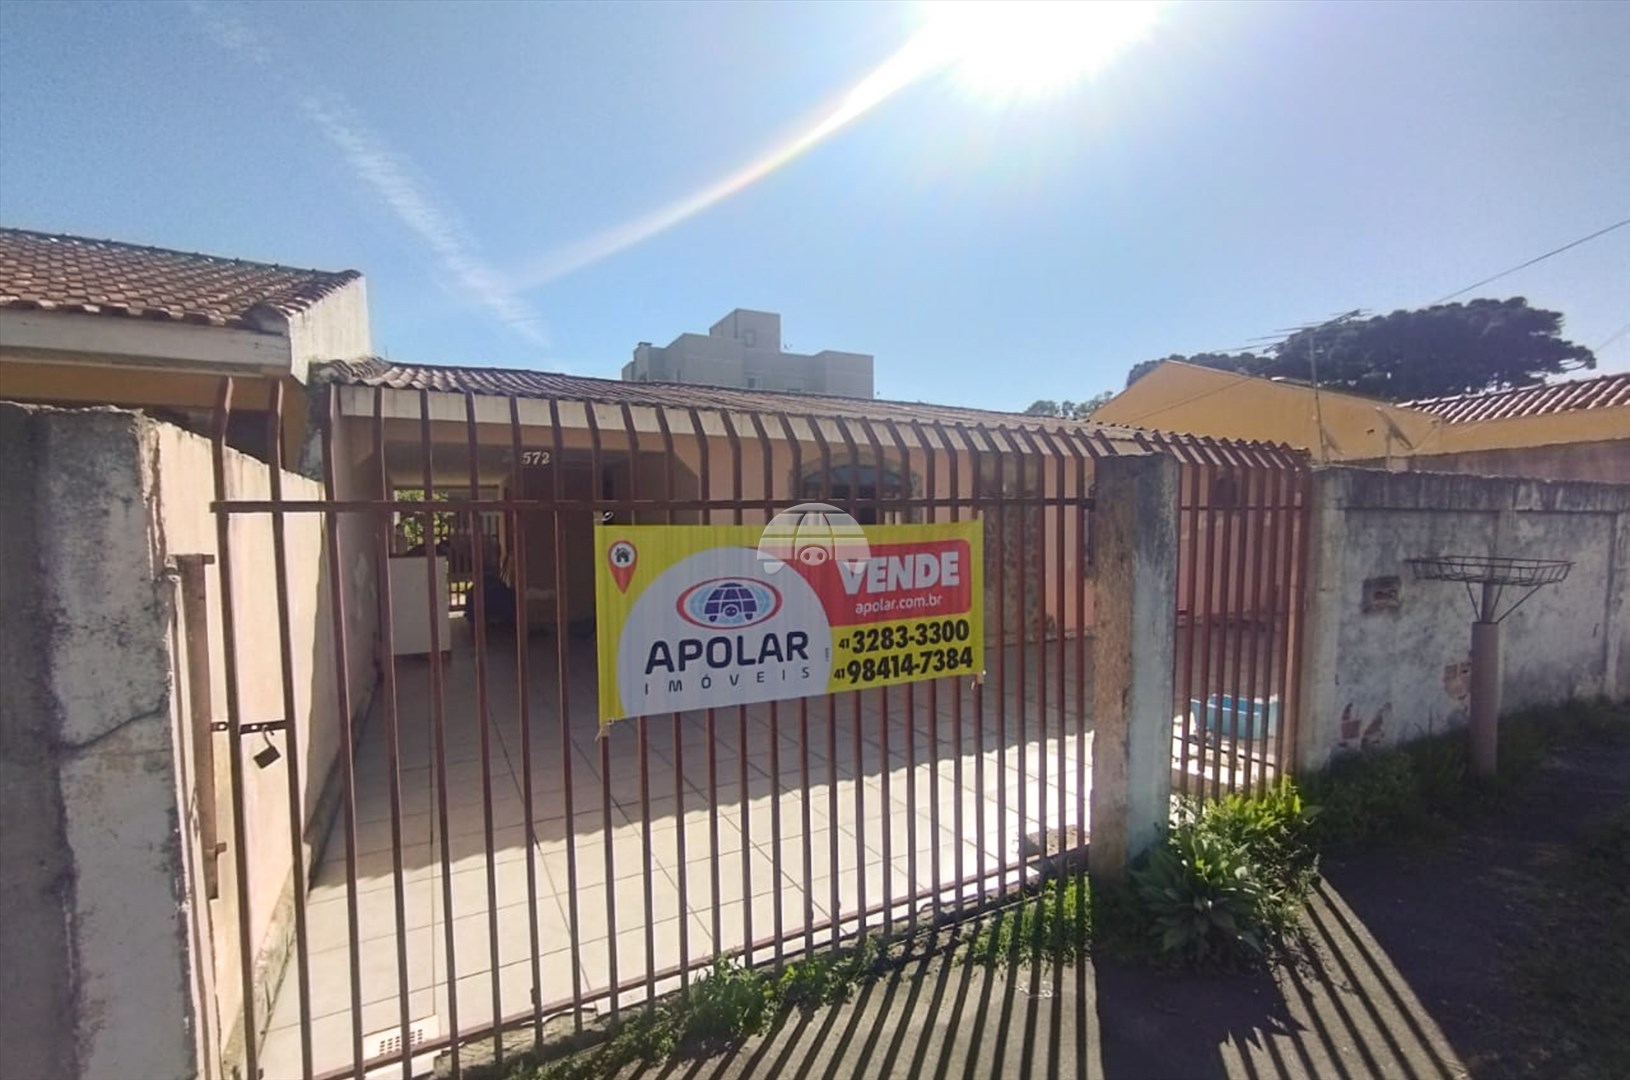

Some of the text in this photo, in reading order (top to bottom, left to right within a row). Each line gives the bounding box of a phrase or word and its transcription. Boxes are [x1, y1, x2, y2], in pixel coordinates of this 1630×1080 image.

[521, 451, 550, 465] 572
[835, 551, 960, 595] VENDE
[855, 593, 943, 616] apolar.com.br
[645, 631, 809, 675] APOLAR
[838, 619, 969, 654] 41 3283-3300
[645, 666, 810, 695] IMÓVEIS
[834, 668, 845, 679] 41
[847, 646, 973, 684] 98414-7384
